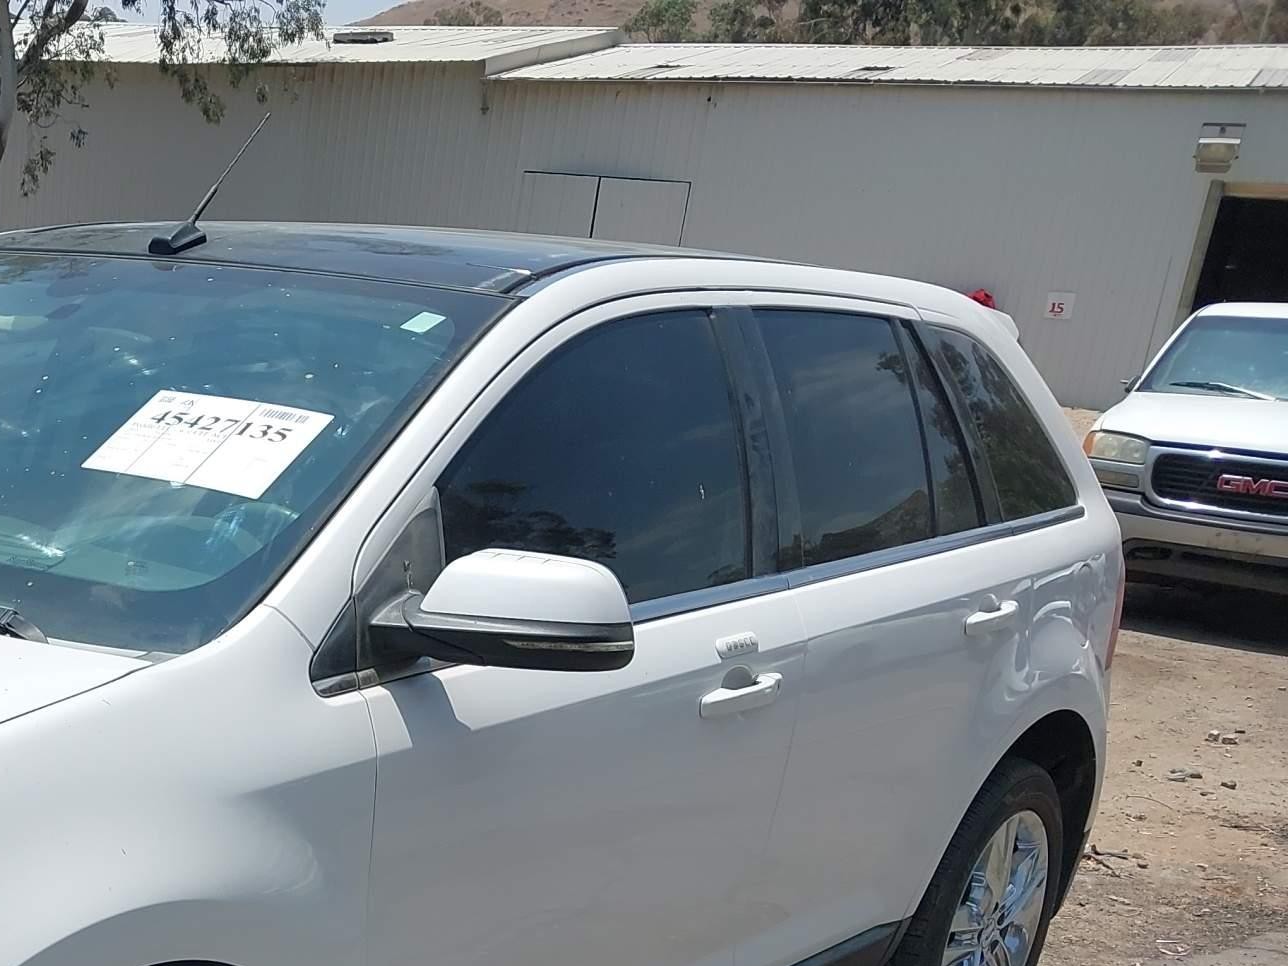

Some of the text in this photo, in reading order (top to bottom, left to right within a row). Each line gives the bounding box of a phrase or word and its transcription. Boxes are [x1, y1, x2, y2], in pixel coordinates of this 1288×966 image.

[1048, 302, 1065, 314] 15
[151, 410, 293, 443] 45427135
[1216, 474, 1288, 499] GMC
